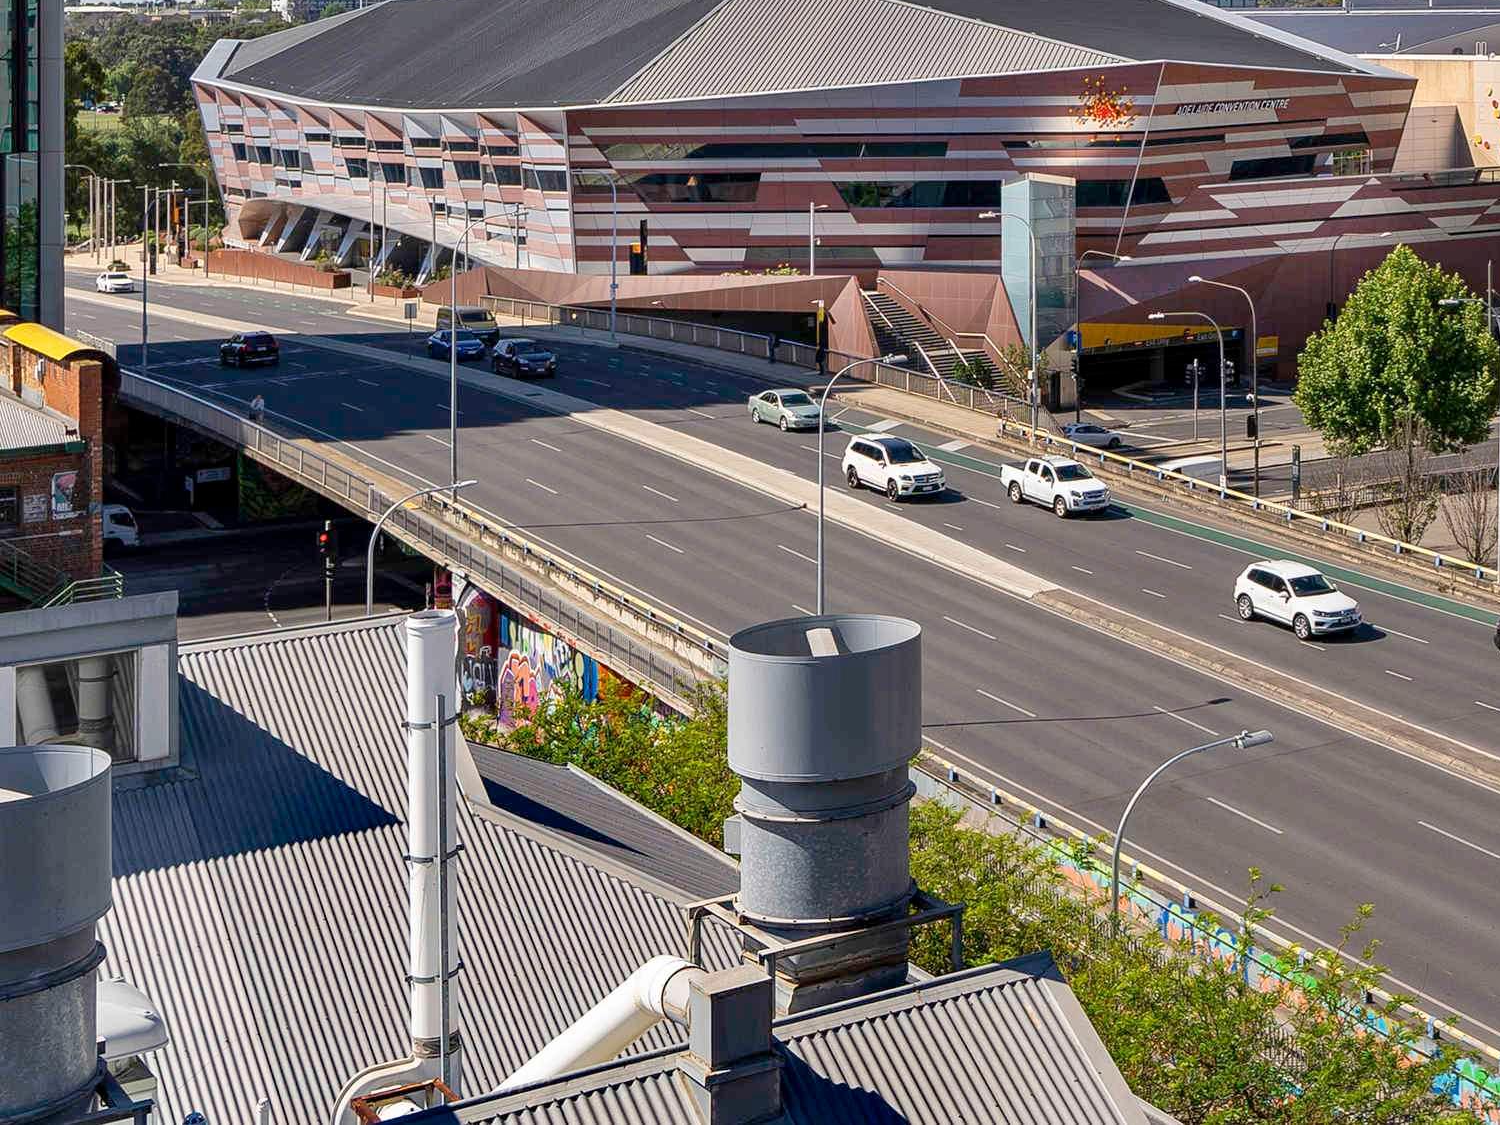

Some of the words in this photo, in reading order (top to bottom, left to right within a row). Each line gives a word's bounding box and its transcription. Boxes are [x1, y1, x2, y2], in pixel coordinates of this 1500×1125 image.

[1175, 103, 1214, 116] ADELAIDE
[1214, 100, 1260, 113] CONVENTION
[1260, 98, 1290, 110] CENTRE
